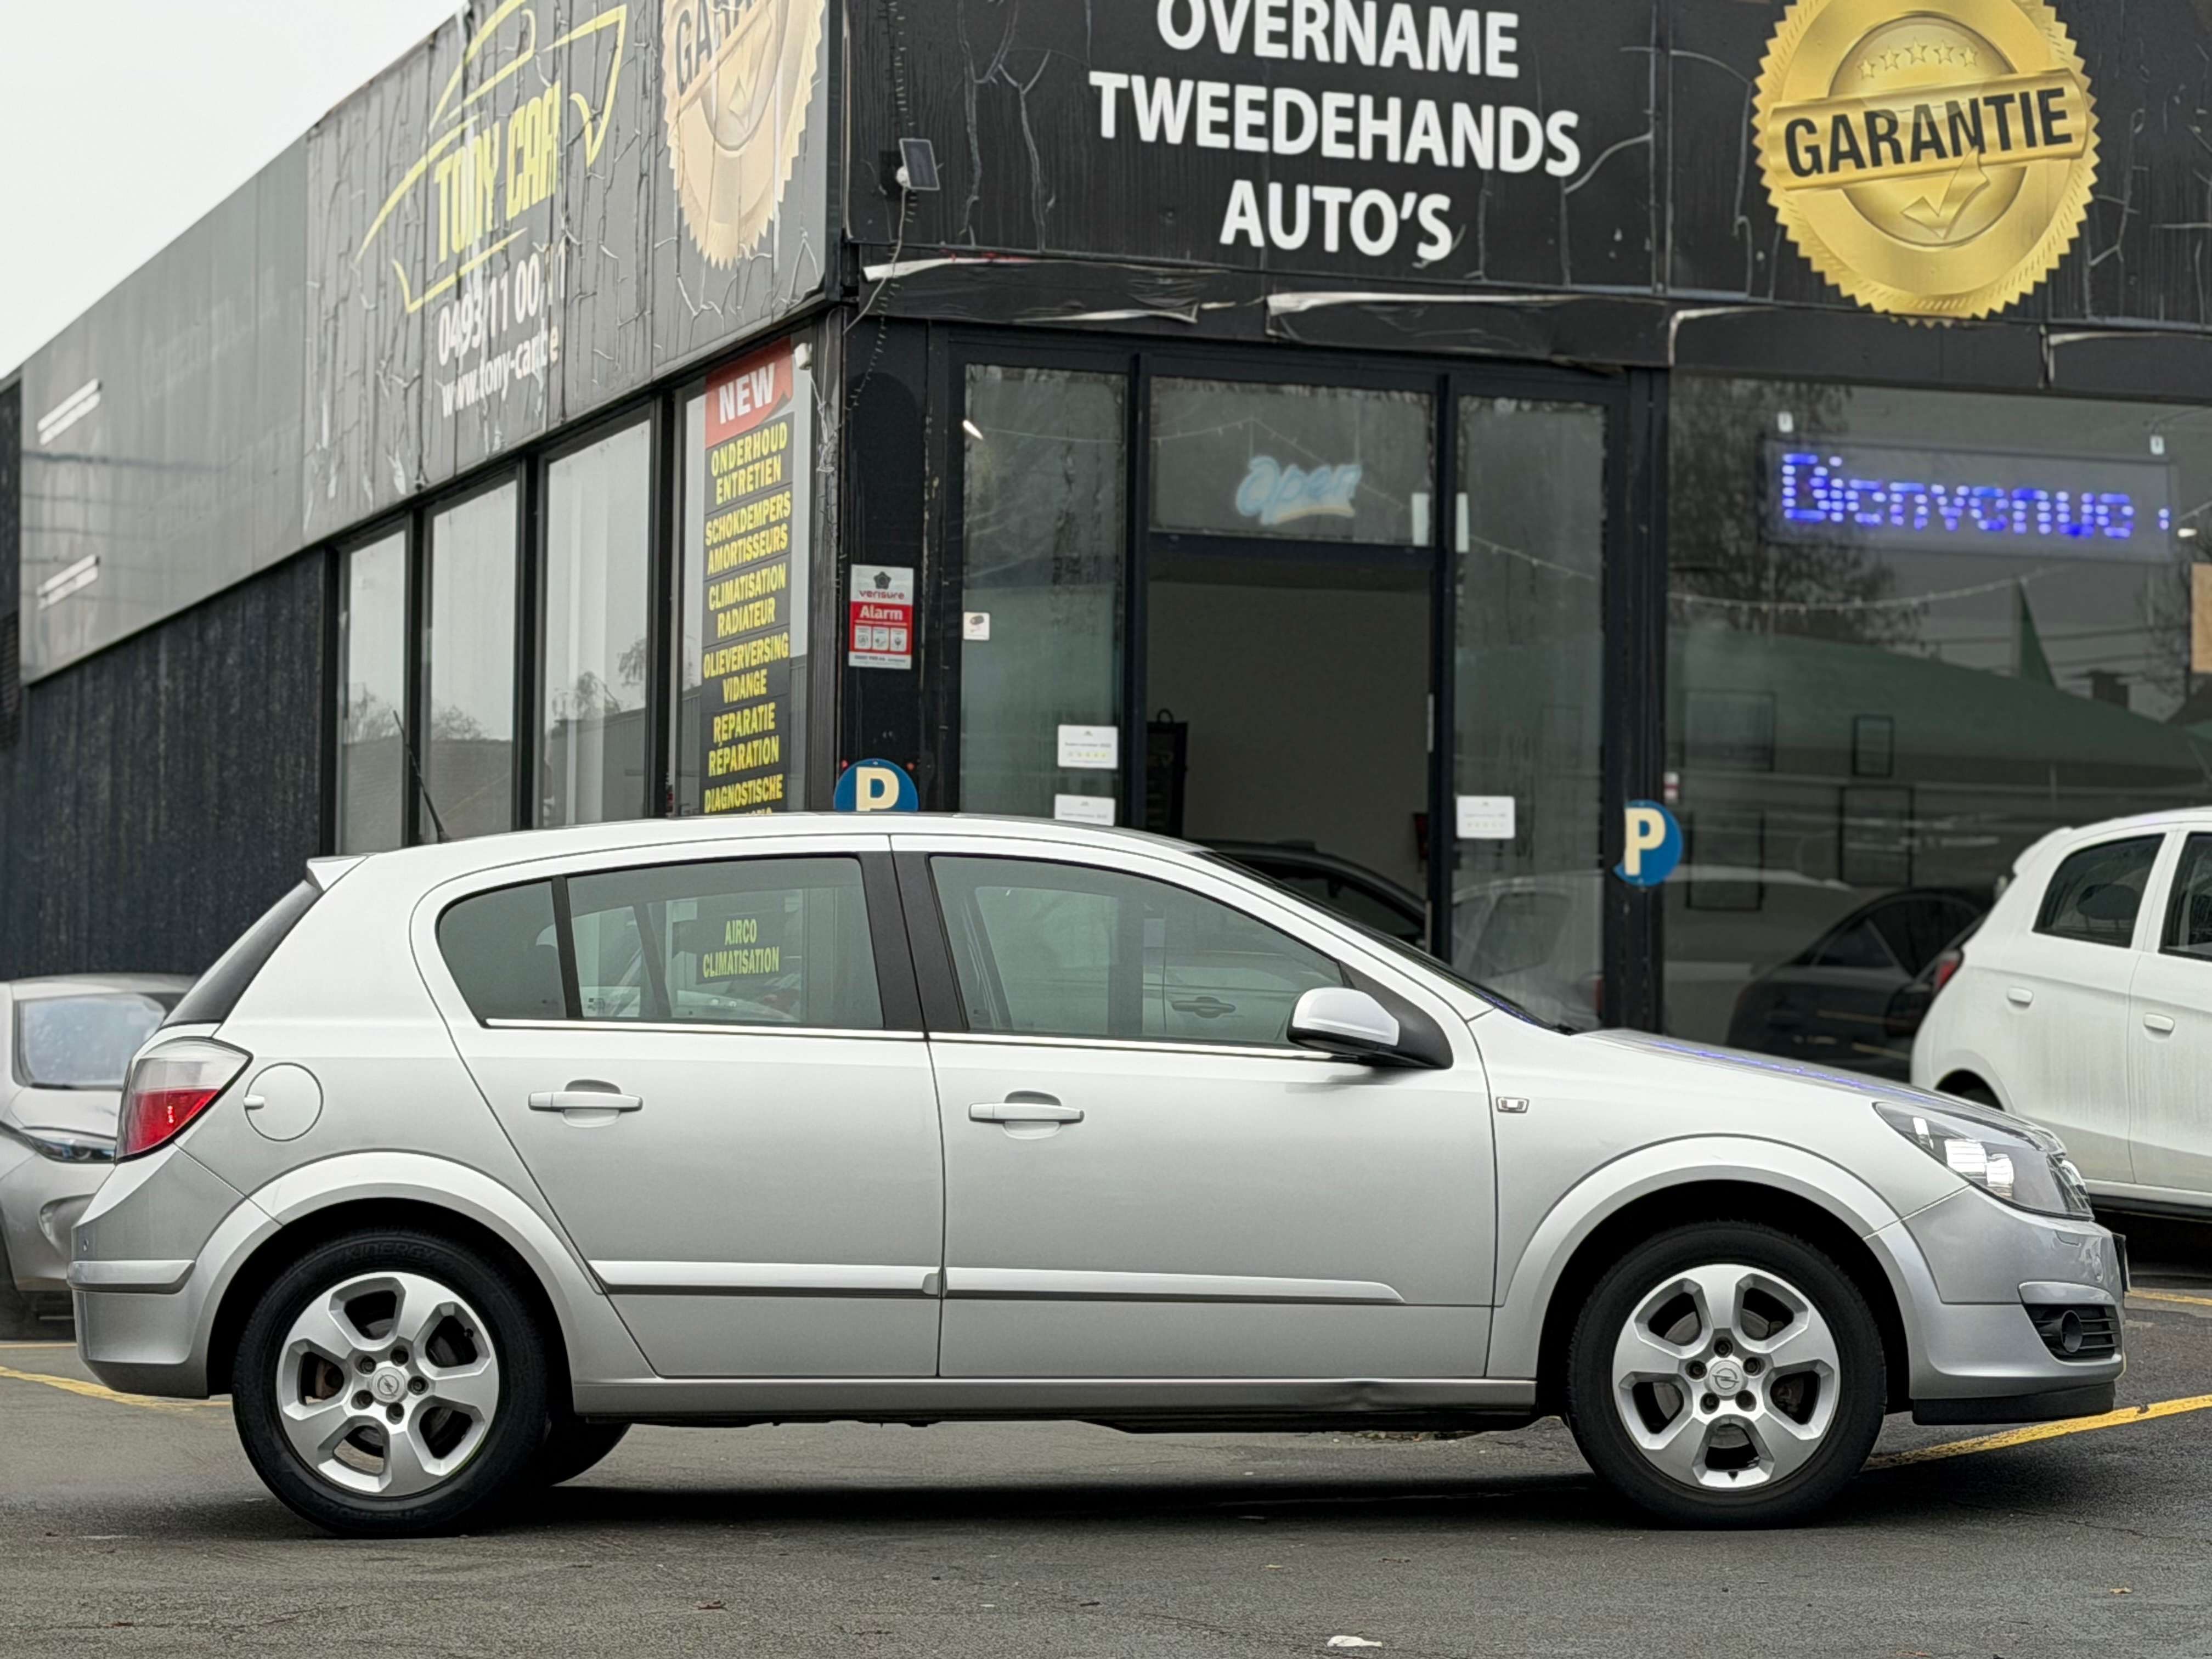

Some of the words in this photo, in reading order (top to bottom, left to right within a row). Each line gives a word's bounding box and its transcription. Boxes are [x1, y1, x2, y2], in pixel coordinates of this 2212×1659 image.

[1156, 0, 1519, 78] OVERNAME
[1088, 70, 1581, 177] TWEEDEHANDS
[1784, 86, 2073, 178] GARANTIE
[434, 121, 500, 263] TONY
[506, 80, 561, 221] CAR
[1219, 179, 1453, 261] AUTO'S
[719, 362, 775, 425] NEW
[711, 421, 788, 477] ONDERHOUD
[716, 454, 782, 505] ENTRETIEN
[705, 490, 791, 546] SCHOKDEMPERS
[707, 523, 788, 576] AMORTISSEURS
[709, 562, 786, 611] CLIMATISATION
[859, 590, 905, 600] verisure
[718, 597, 776, 639] RADIATEUR
[860, 605, 904, 621] Alarm
[703, 632, 789, 679] OLIEVERVERSING
[723, 669, 768, 704] VIDANGE
[714, 702, 776, 743] REPARATIE
[704, 774, 783, 814] DIAGNOSTISCHE
[856, 766, 899, 812] P
[1624, 808, 1666, 876] P
[725, 918, 757, 946] AIRCO
[703, 946, 780, 978] CLIMATISATION
